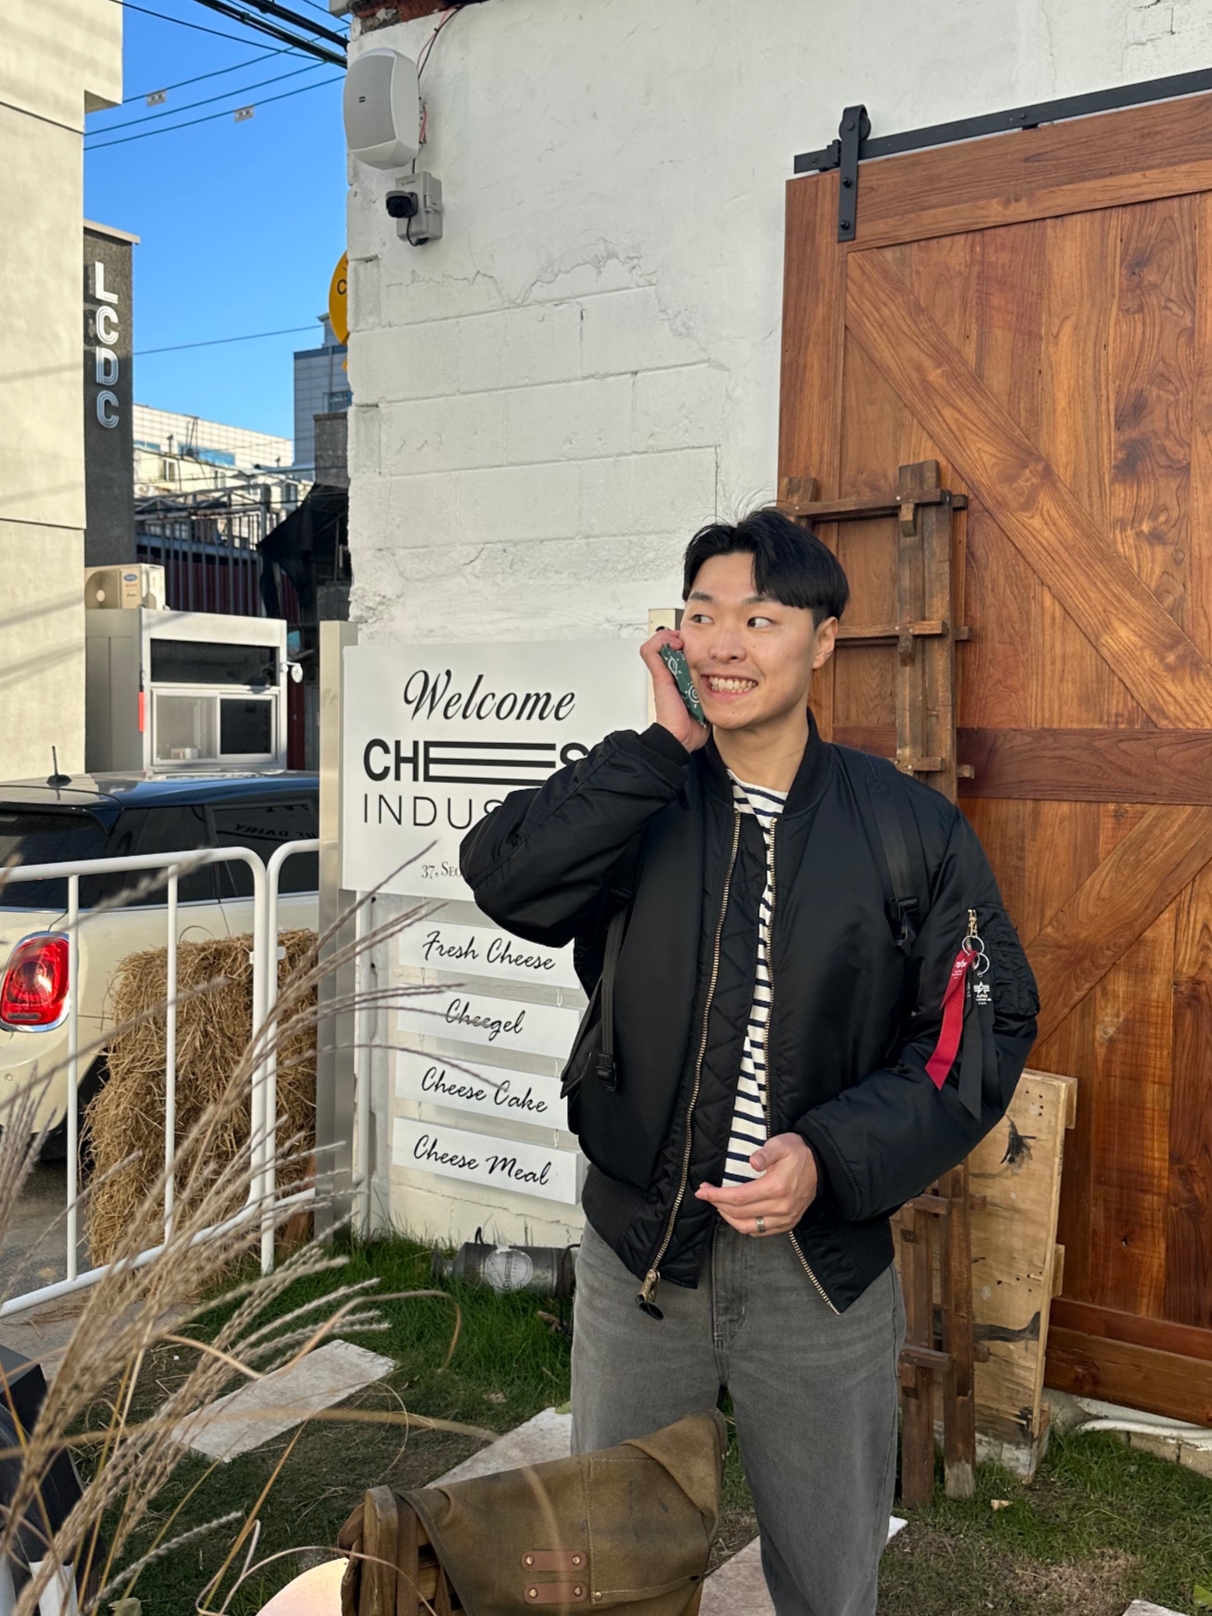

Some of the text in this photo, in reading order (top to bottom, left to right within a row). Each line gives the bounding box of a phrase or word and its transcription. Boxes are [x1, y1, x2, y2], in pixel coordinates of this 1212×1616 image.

[95, 261, 119, 429] LCDC
[403, 669, 576, 721] Welcome
[422, 930, 556, 970] Fresh Cheese
[421, 1066, 548, 1113] Cheese Cake
[413, 1134, 553, 1186] Cheese Meal
